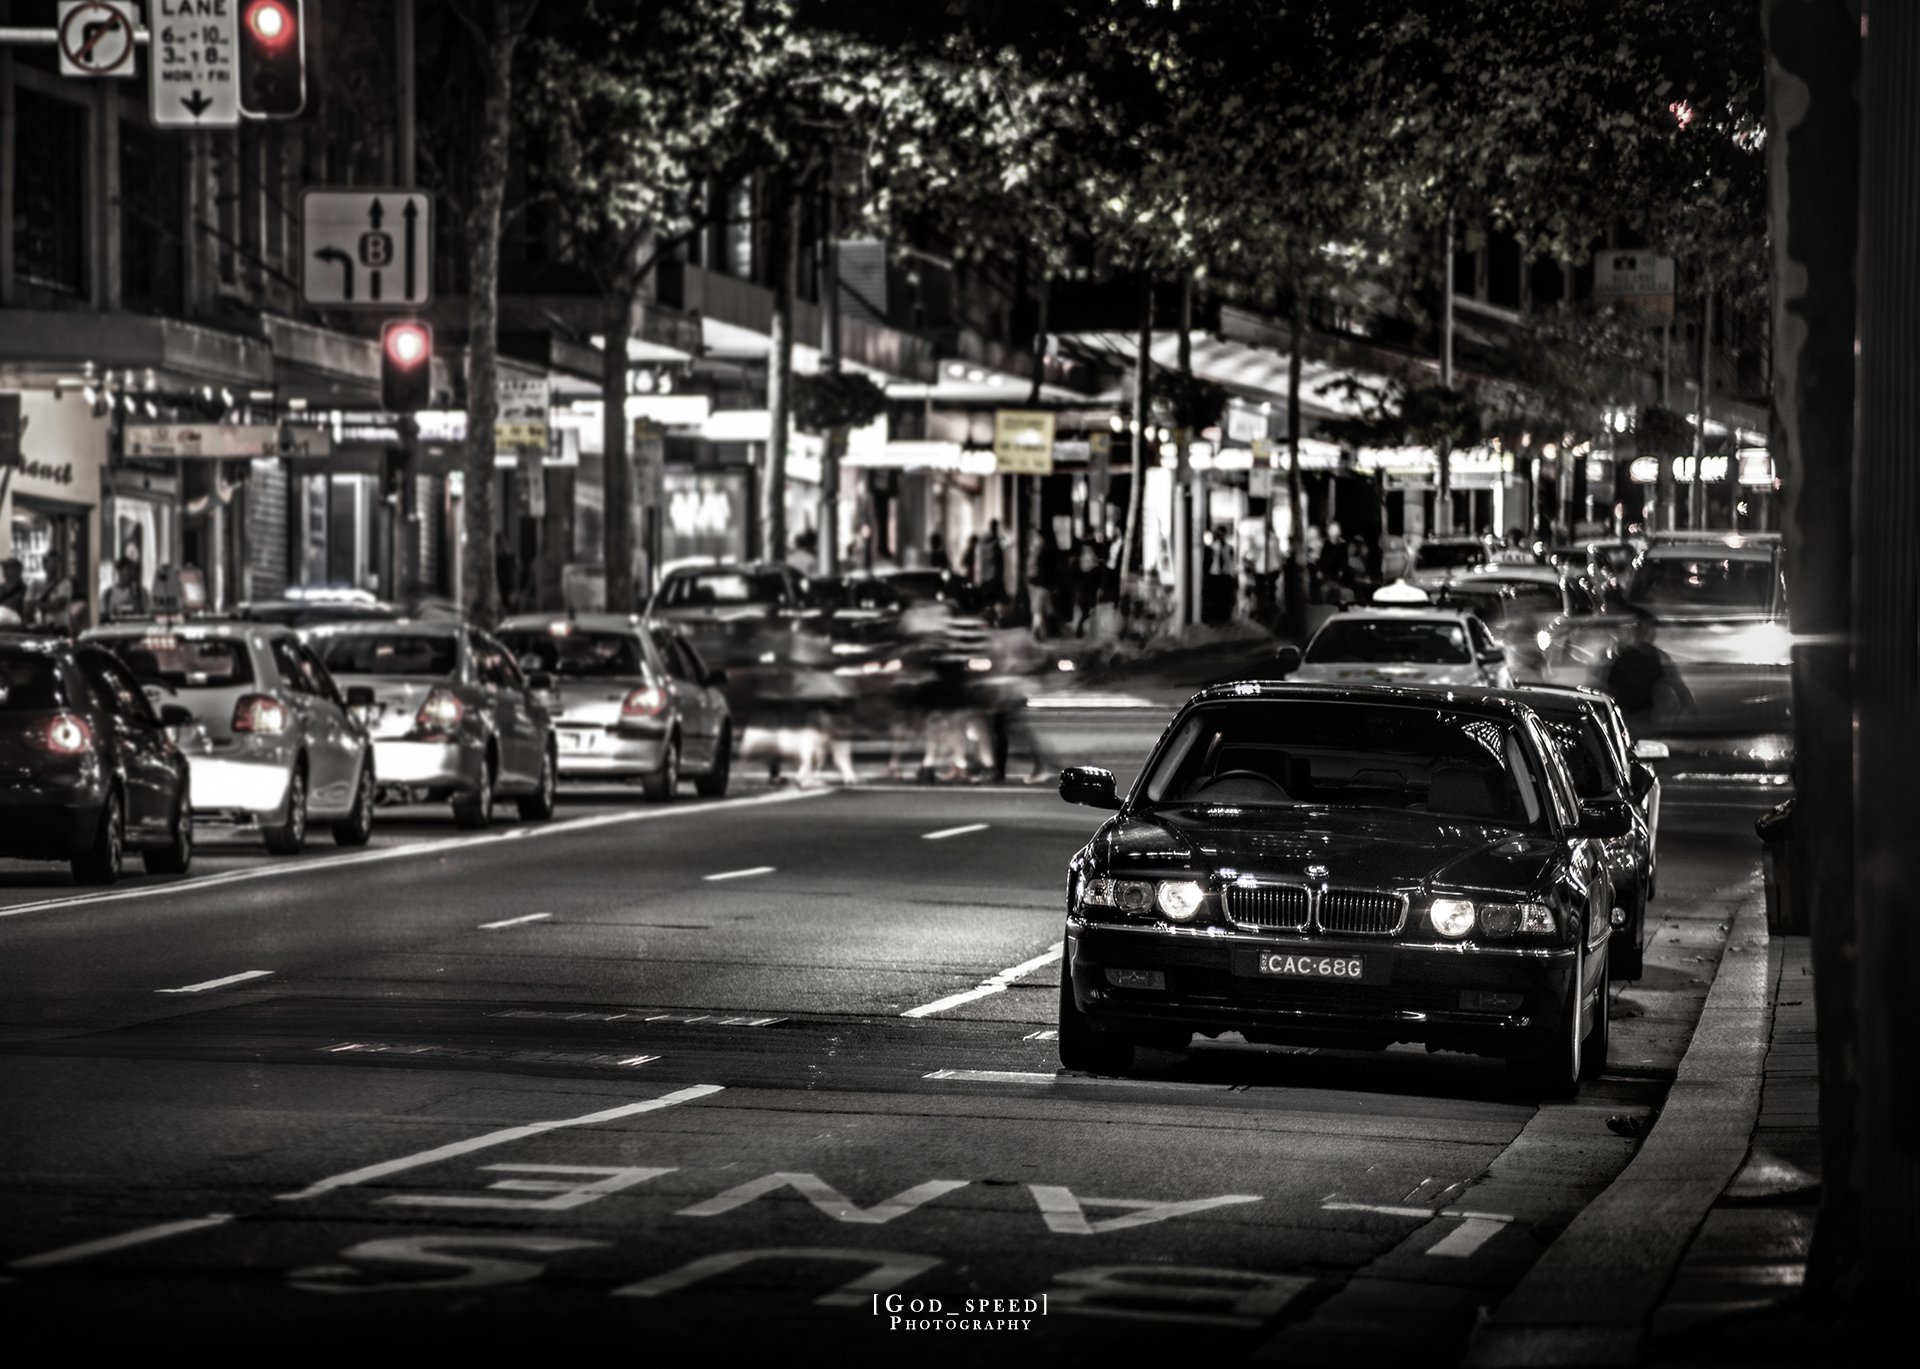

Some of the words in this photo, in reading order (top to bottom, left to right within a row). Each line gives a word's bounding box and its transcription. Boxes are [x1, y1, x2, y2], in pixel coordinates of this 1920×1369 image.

[161, 0, 227, 16] LANE
[162, 69, 193, 82] MON
[208, 69, 230, 83] FRI
[1502, 553, 1526, 562] TAXI
[371, 1166, 1515, 1258] LANE
[287, 1236, 1319, 1327] BUS
